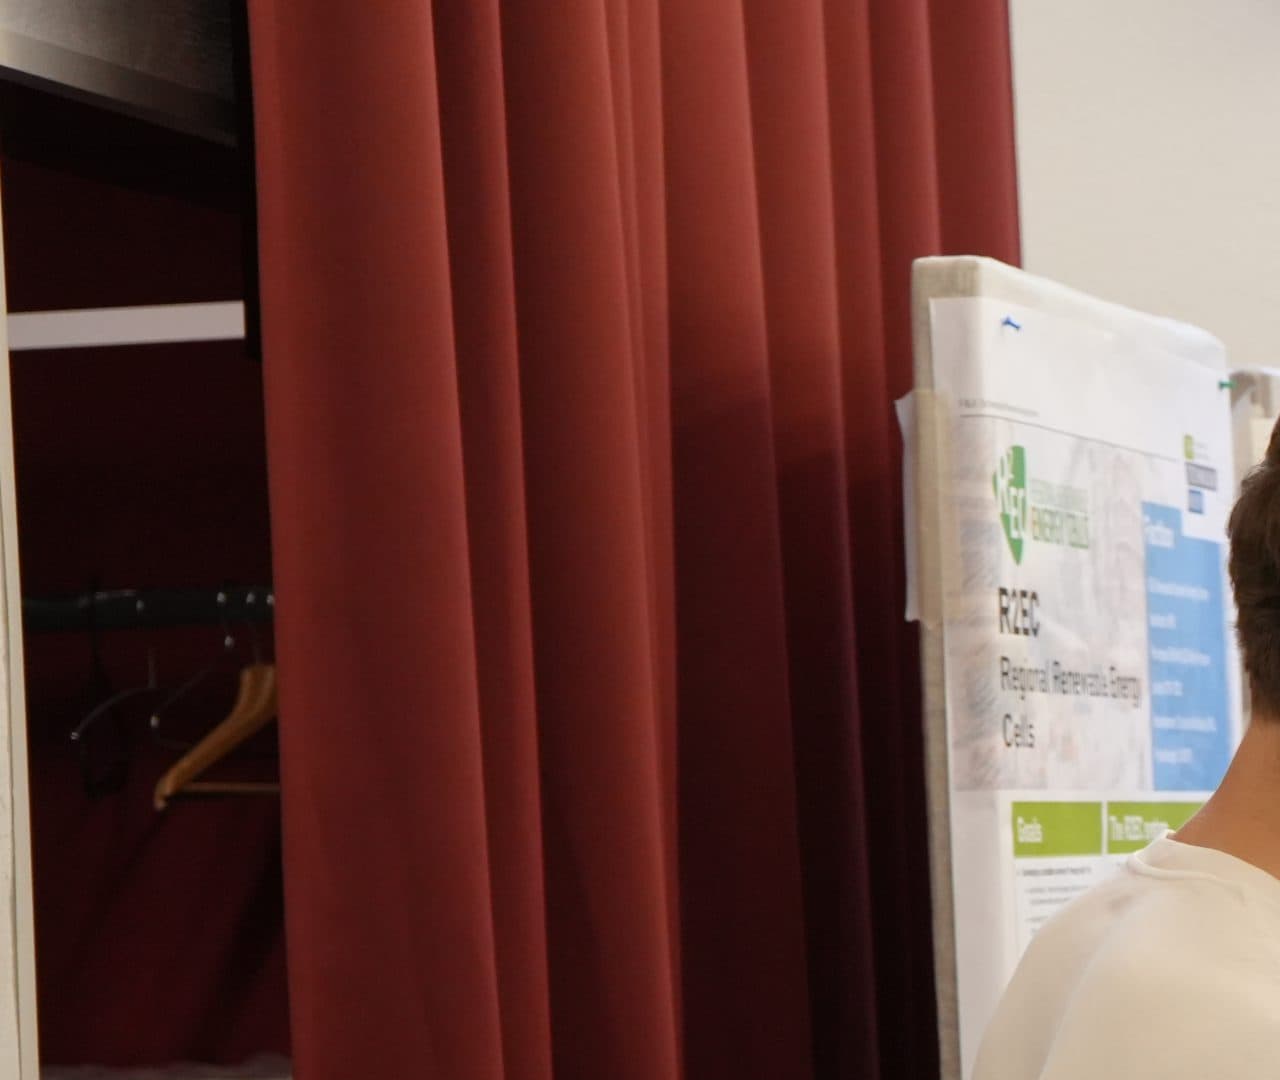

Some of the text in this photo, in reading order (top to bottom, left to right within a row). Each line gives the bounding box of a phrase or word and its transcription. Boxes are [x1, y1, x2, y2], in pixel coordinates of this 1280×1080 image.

[998, 586, 1040, 637] R2EC
[1000, 655, 1049, 701] Regional
[1002, 712, 1035, 748] Cells
